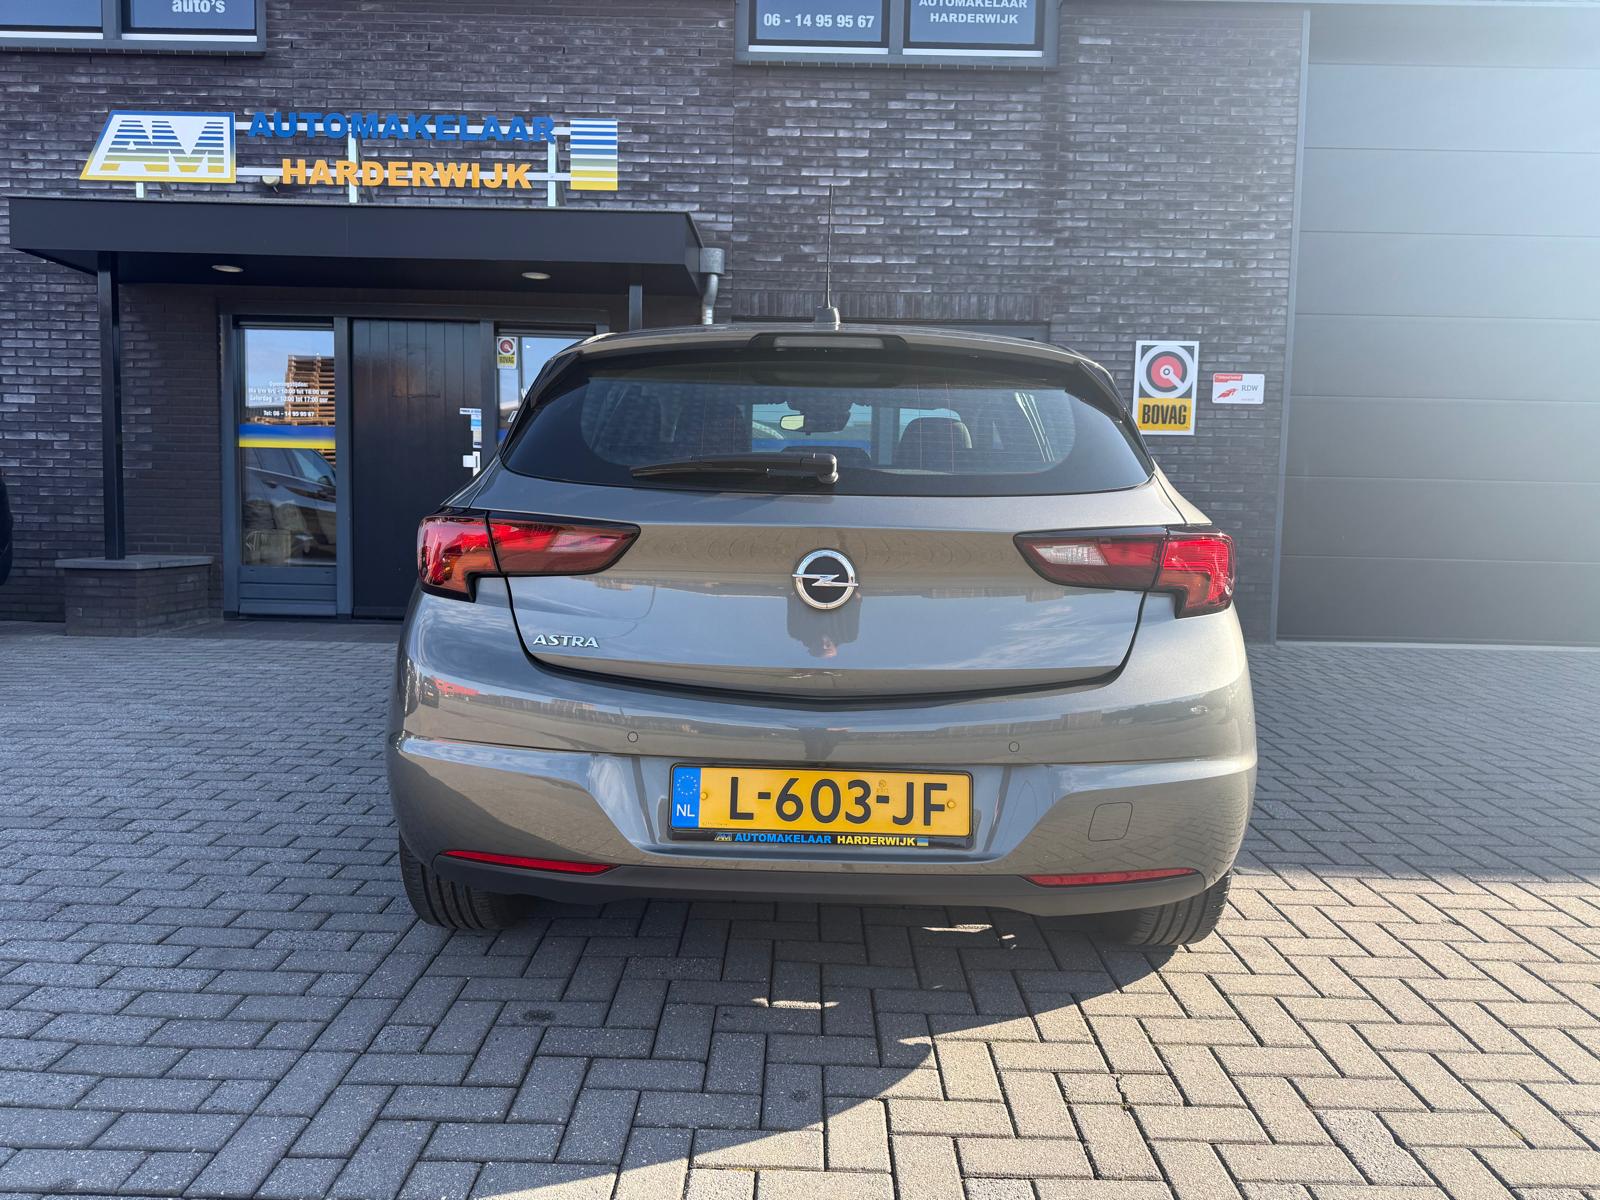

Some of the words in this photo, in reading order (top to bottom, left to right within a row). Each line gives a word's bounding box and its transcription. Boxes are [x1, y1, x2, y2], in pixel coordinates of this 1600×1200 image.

[172, 0, 226, 13] auto's
[919, 0, 1028, 8] AUTOMAKELAAR
[763, 13, 781, 26] 06
[795, 14, 812, 26] 14
[815, 14, 833, 27] 95
[836, 15, 854, 27] 95
[857, 15, 875, 28] 67
[930, 12, 1019, 24] HARDERWIJK
[247, 111, 556, 144] AUTOMAKELAAR
[281, 158, 533, 189] HARDERWIJK
[1241, 384, 1259, 392] RDW
[1142, 404, 1187, 425] BOVAG
[532, 634, 600, 649] ASTRA
[729, 776, 948, 826] L-603-JF
[676, 803, 695, 817] NL
[734, 833, 832, 844] AUTOMAKELAAR
[837, 835, 916, 847] HARDERWIJK
